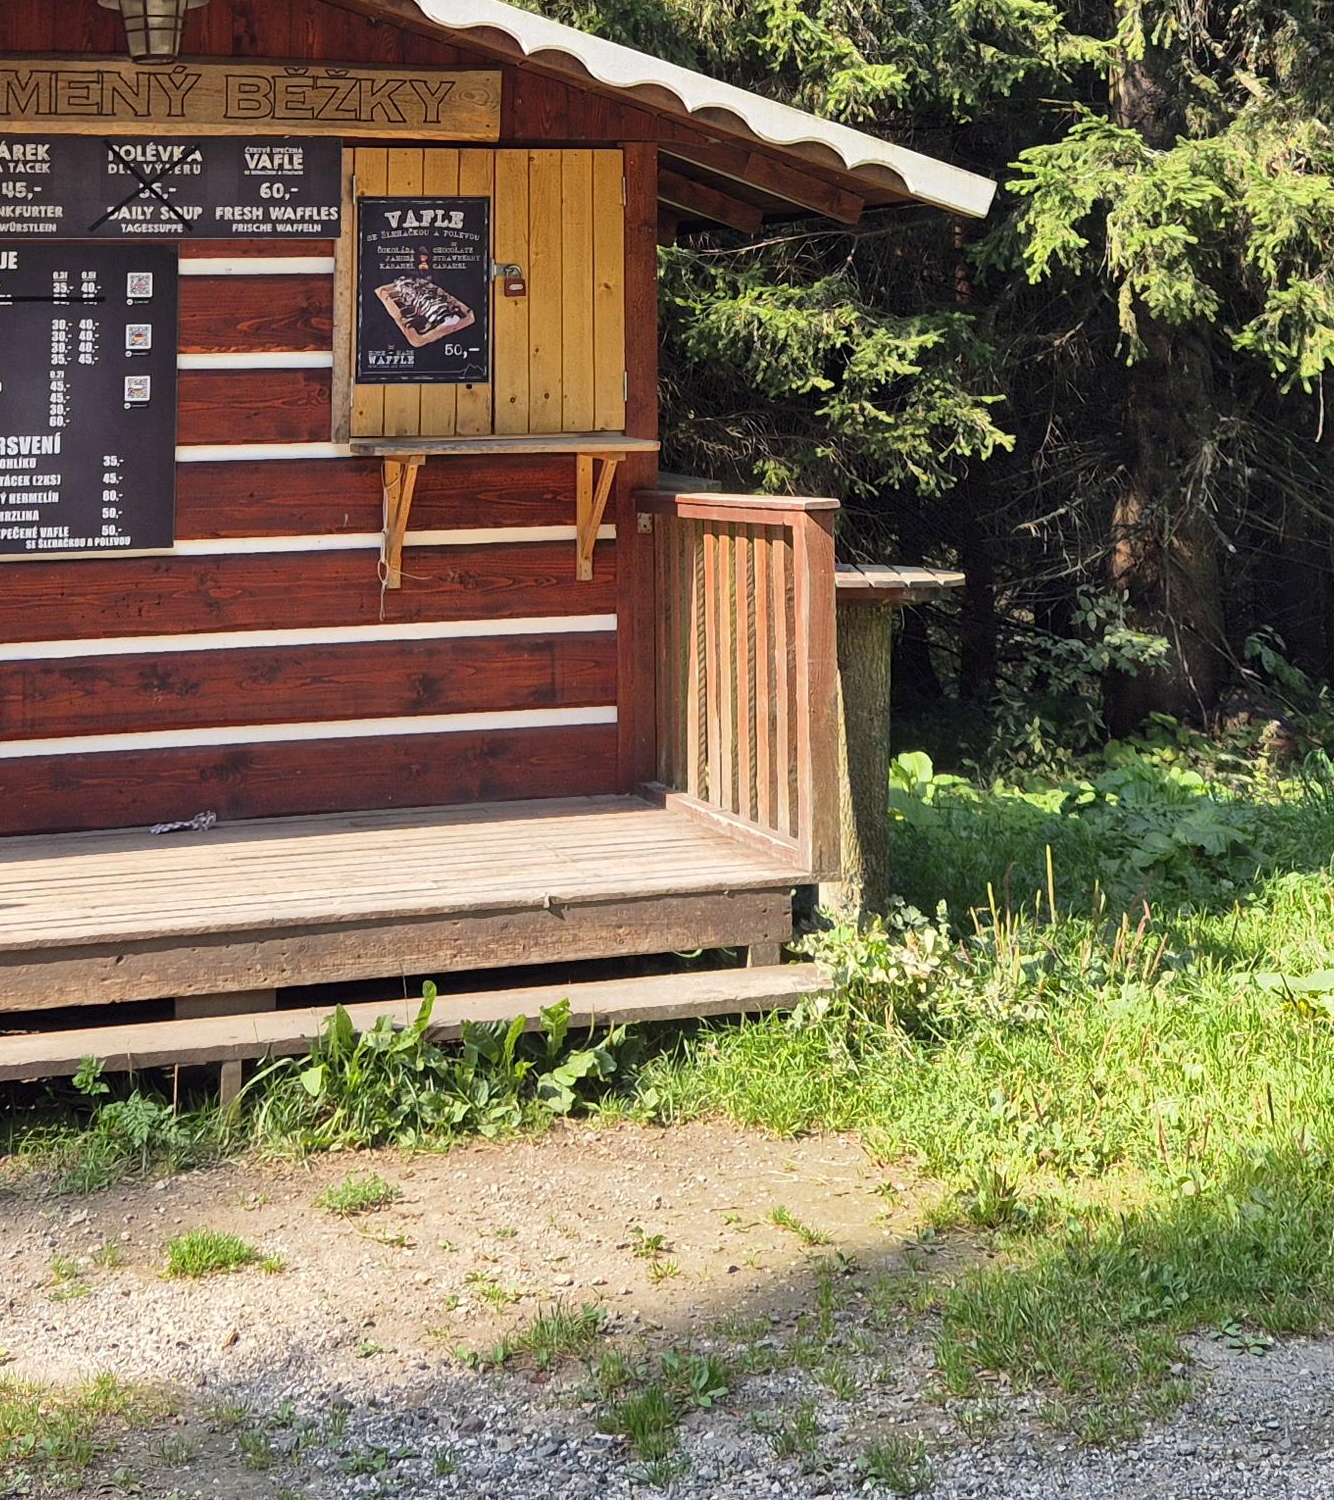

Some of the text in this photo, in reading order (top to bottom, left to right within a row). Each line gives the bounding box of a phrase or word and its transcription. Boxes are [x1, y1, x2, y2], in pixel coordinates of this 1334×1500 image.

[224, 67, 456, 124] BĚŽKY
[8, 160, 51, 175] TÁCEK
[1, 181, 43, 201] 45,-
[259, 181, 300, 201] 60,-
[215, 206, 339, 221] FRESH WAFFLES
[384, 209, 465, 229] VAFLE
[0, 221, 57, 233] WÜRSTLEIN
[120, 223, 184, 233] TAGESSUPPE
[232, 222, 322, 233] FRISCHE WAFFELN
[444, 343, 480, 359] 50,-
[40, 526, 69, 538] VAFLE
